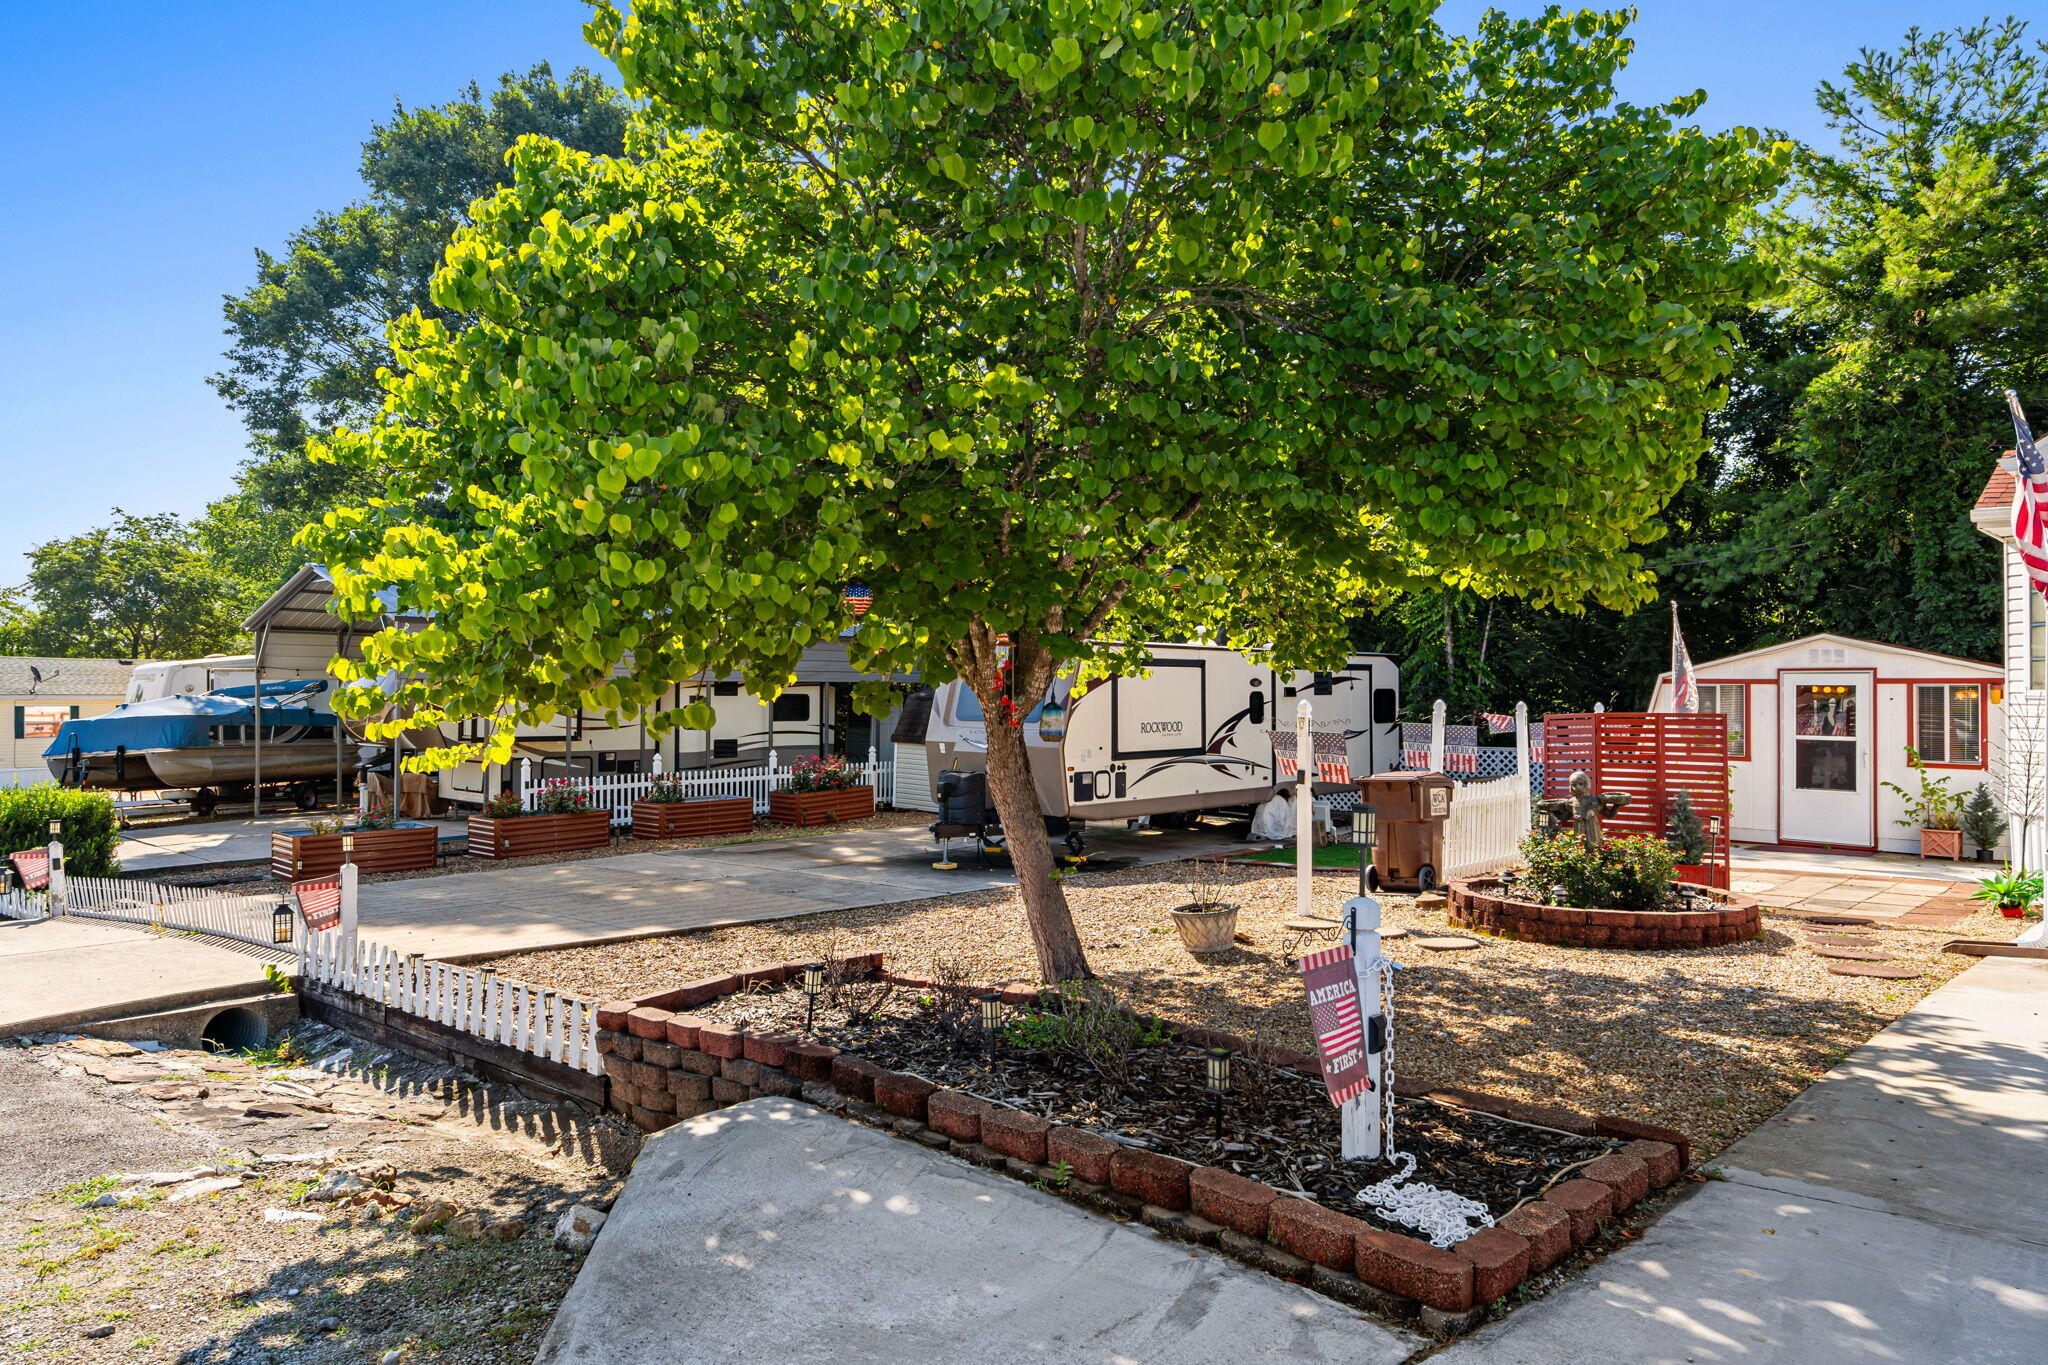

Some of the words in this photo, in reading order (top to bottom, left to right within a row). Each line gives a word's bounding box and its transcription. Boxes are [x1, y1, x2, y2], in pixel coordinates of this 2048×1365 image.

[1140, 721, 1182, 733] ROCKWOOD
[1404, 742, 1431, 752] AMERICA
[1446, 745, 1476, 755] AMERICA
[1316, 754, 1347, 765] AMERICA
[1309, 979, 1356, 1007] AMERICA
[1332, 1048, 1358, 1075] FIRST
